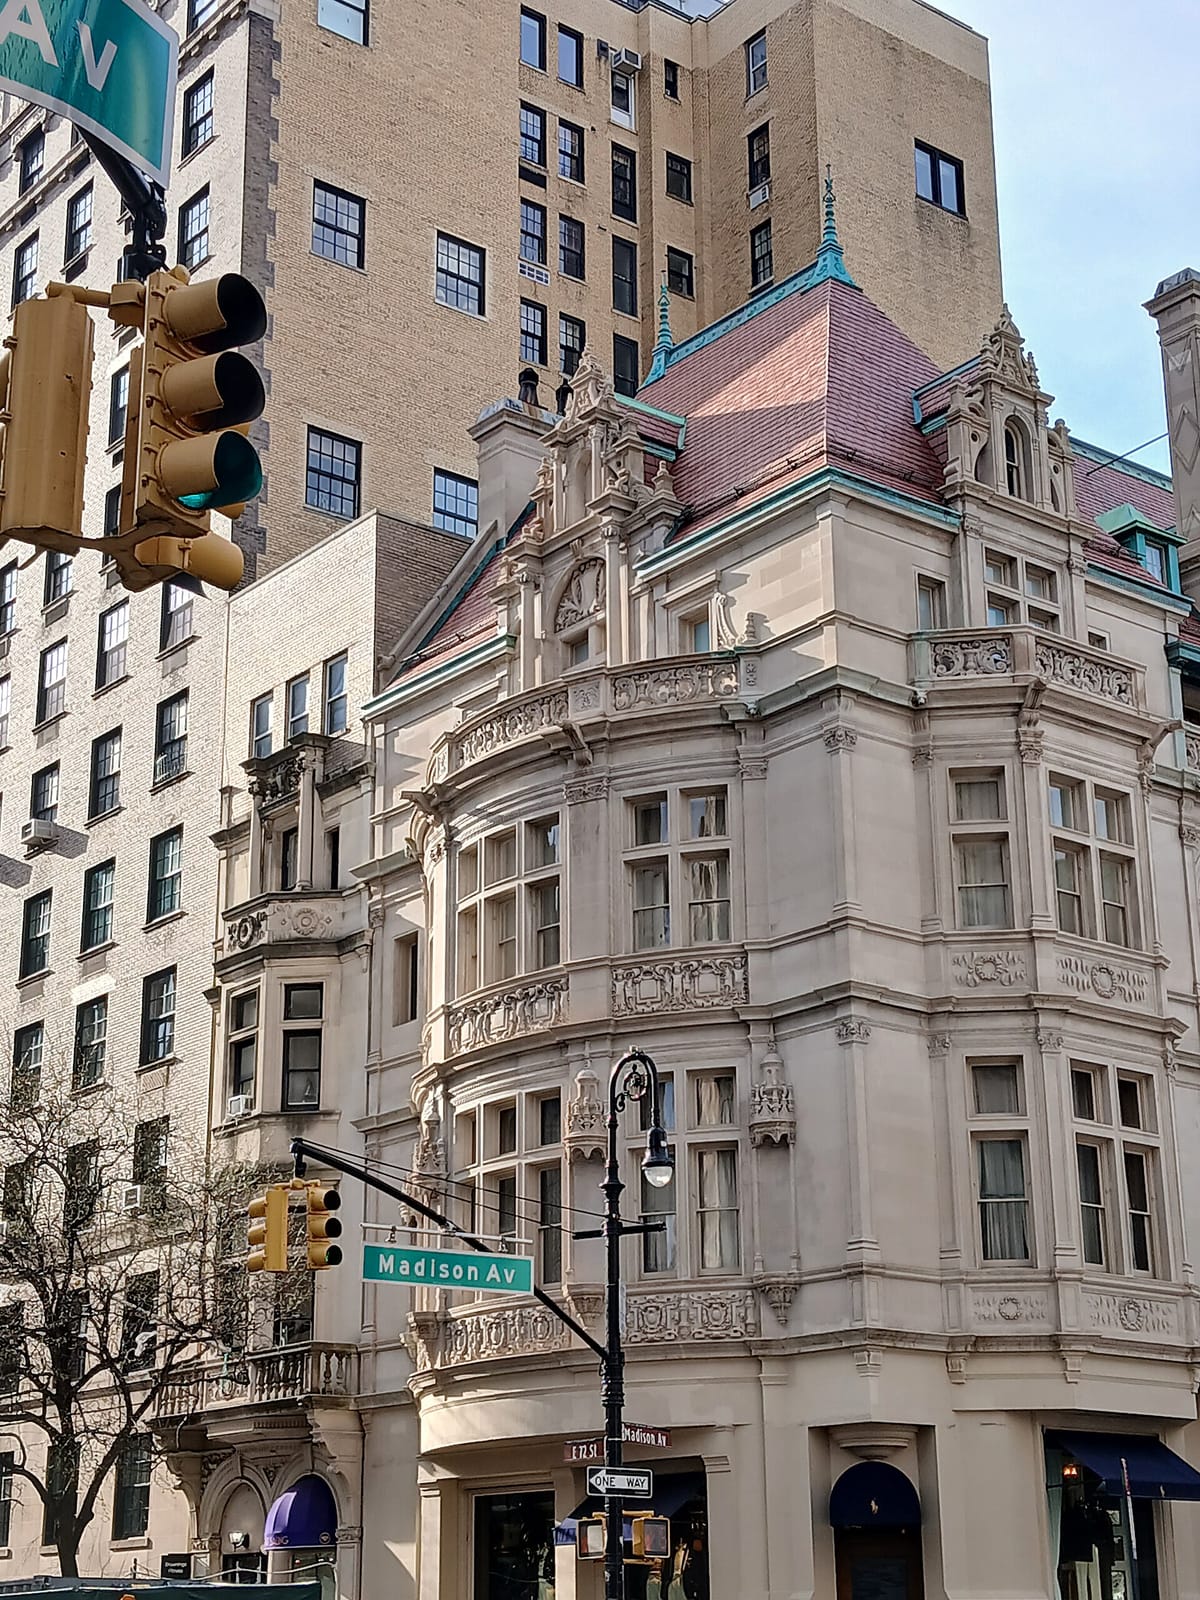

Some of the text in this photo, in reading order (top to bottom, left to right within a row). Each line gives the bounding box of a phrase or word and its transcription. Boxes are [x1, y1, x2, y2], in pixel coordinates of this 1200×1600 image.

[0, 0, 118, 92] Av
[379, 1253, 516, 1284] Madison Av
[624, 1427, 667, 1447] Madison Av
[572, 1446, 577, 1460] E
[579, 1445, 588, 1459] 72
[594, 1476, 646, 1488] ONE WAY
